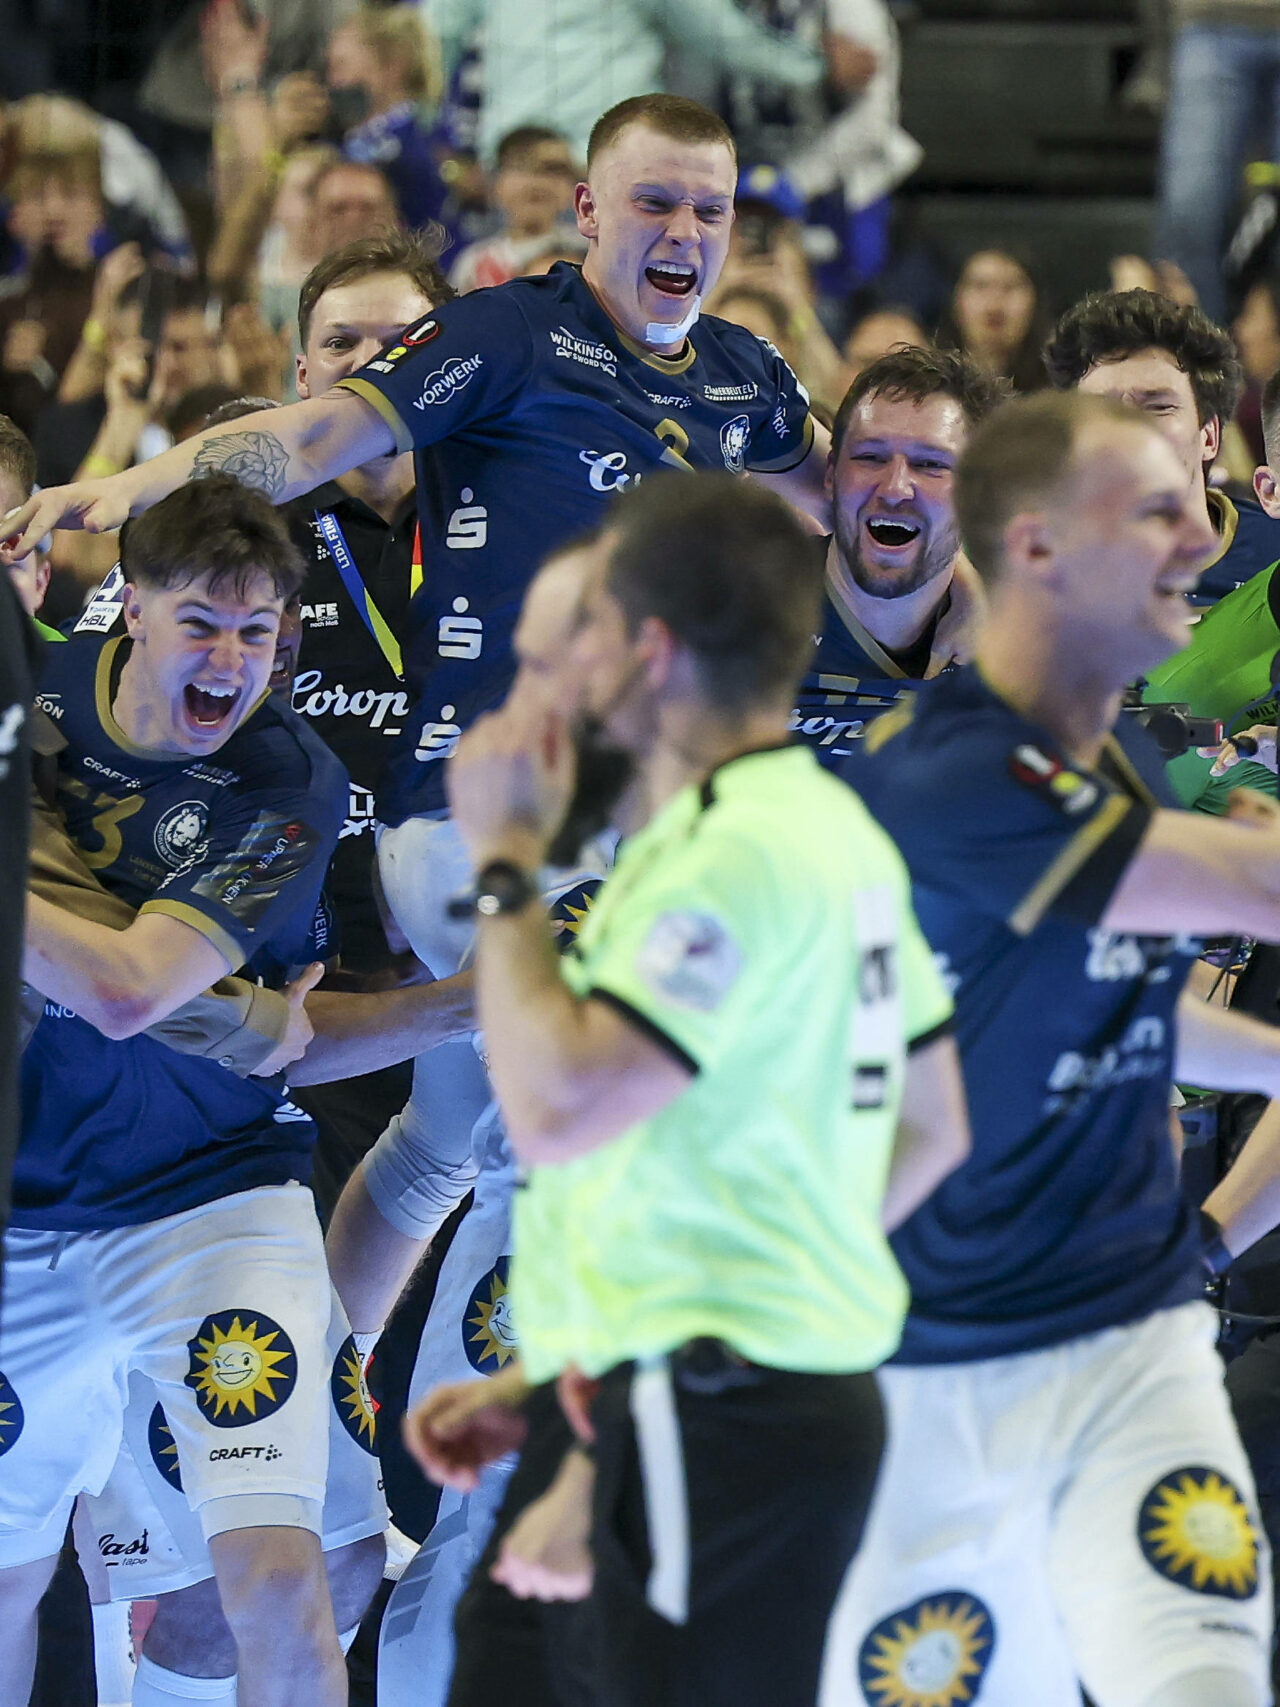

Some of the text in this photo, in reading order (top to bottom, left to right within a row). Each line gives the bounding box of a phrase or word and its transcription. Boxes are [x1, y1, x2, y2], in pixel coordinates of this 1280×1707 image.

[572, 353, 600, 368] SWORD
[413, 354, 484, 411] VORWERK
[333, 540, 351, 569] LIDL
[80, 614, 107, 627] HBL
[82, 756, 131, 784] CRAFT
[209, 1446, 266, 1461] CRAFT
